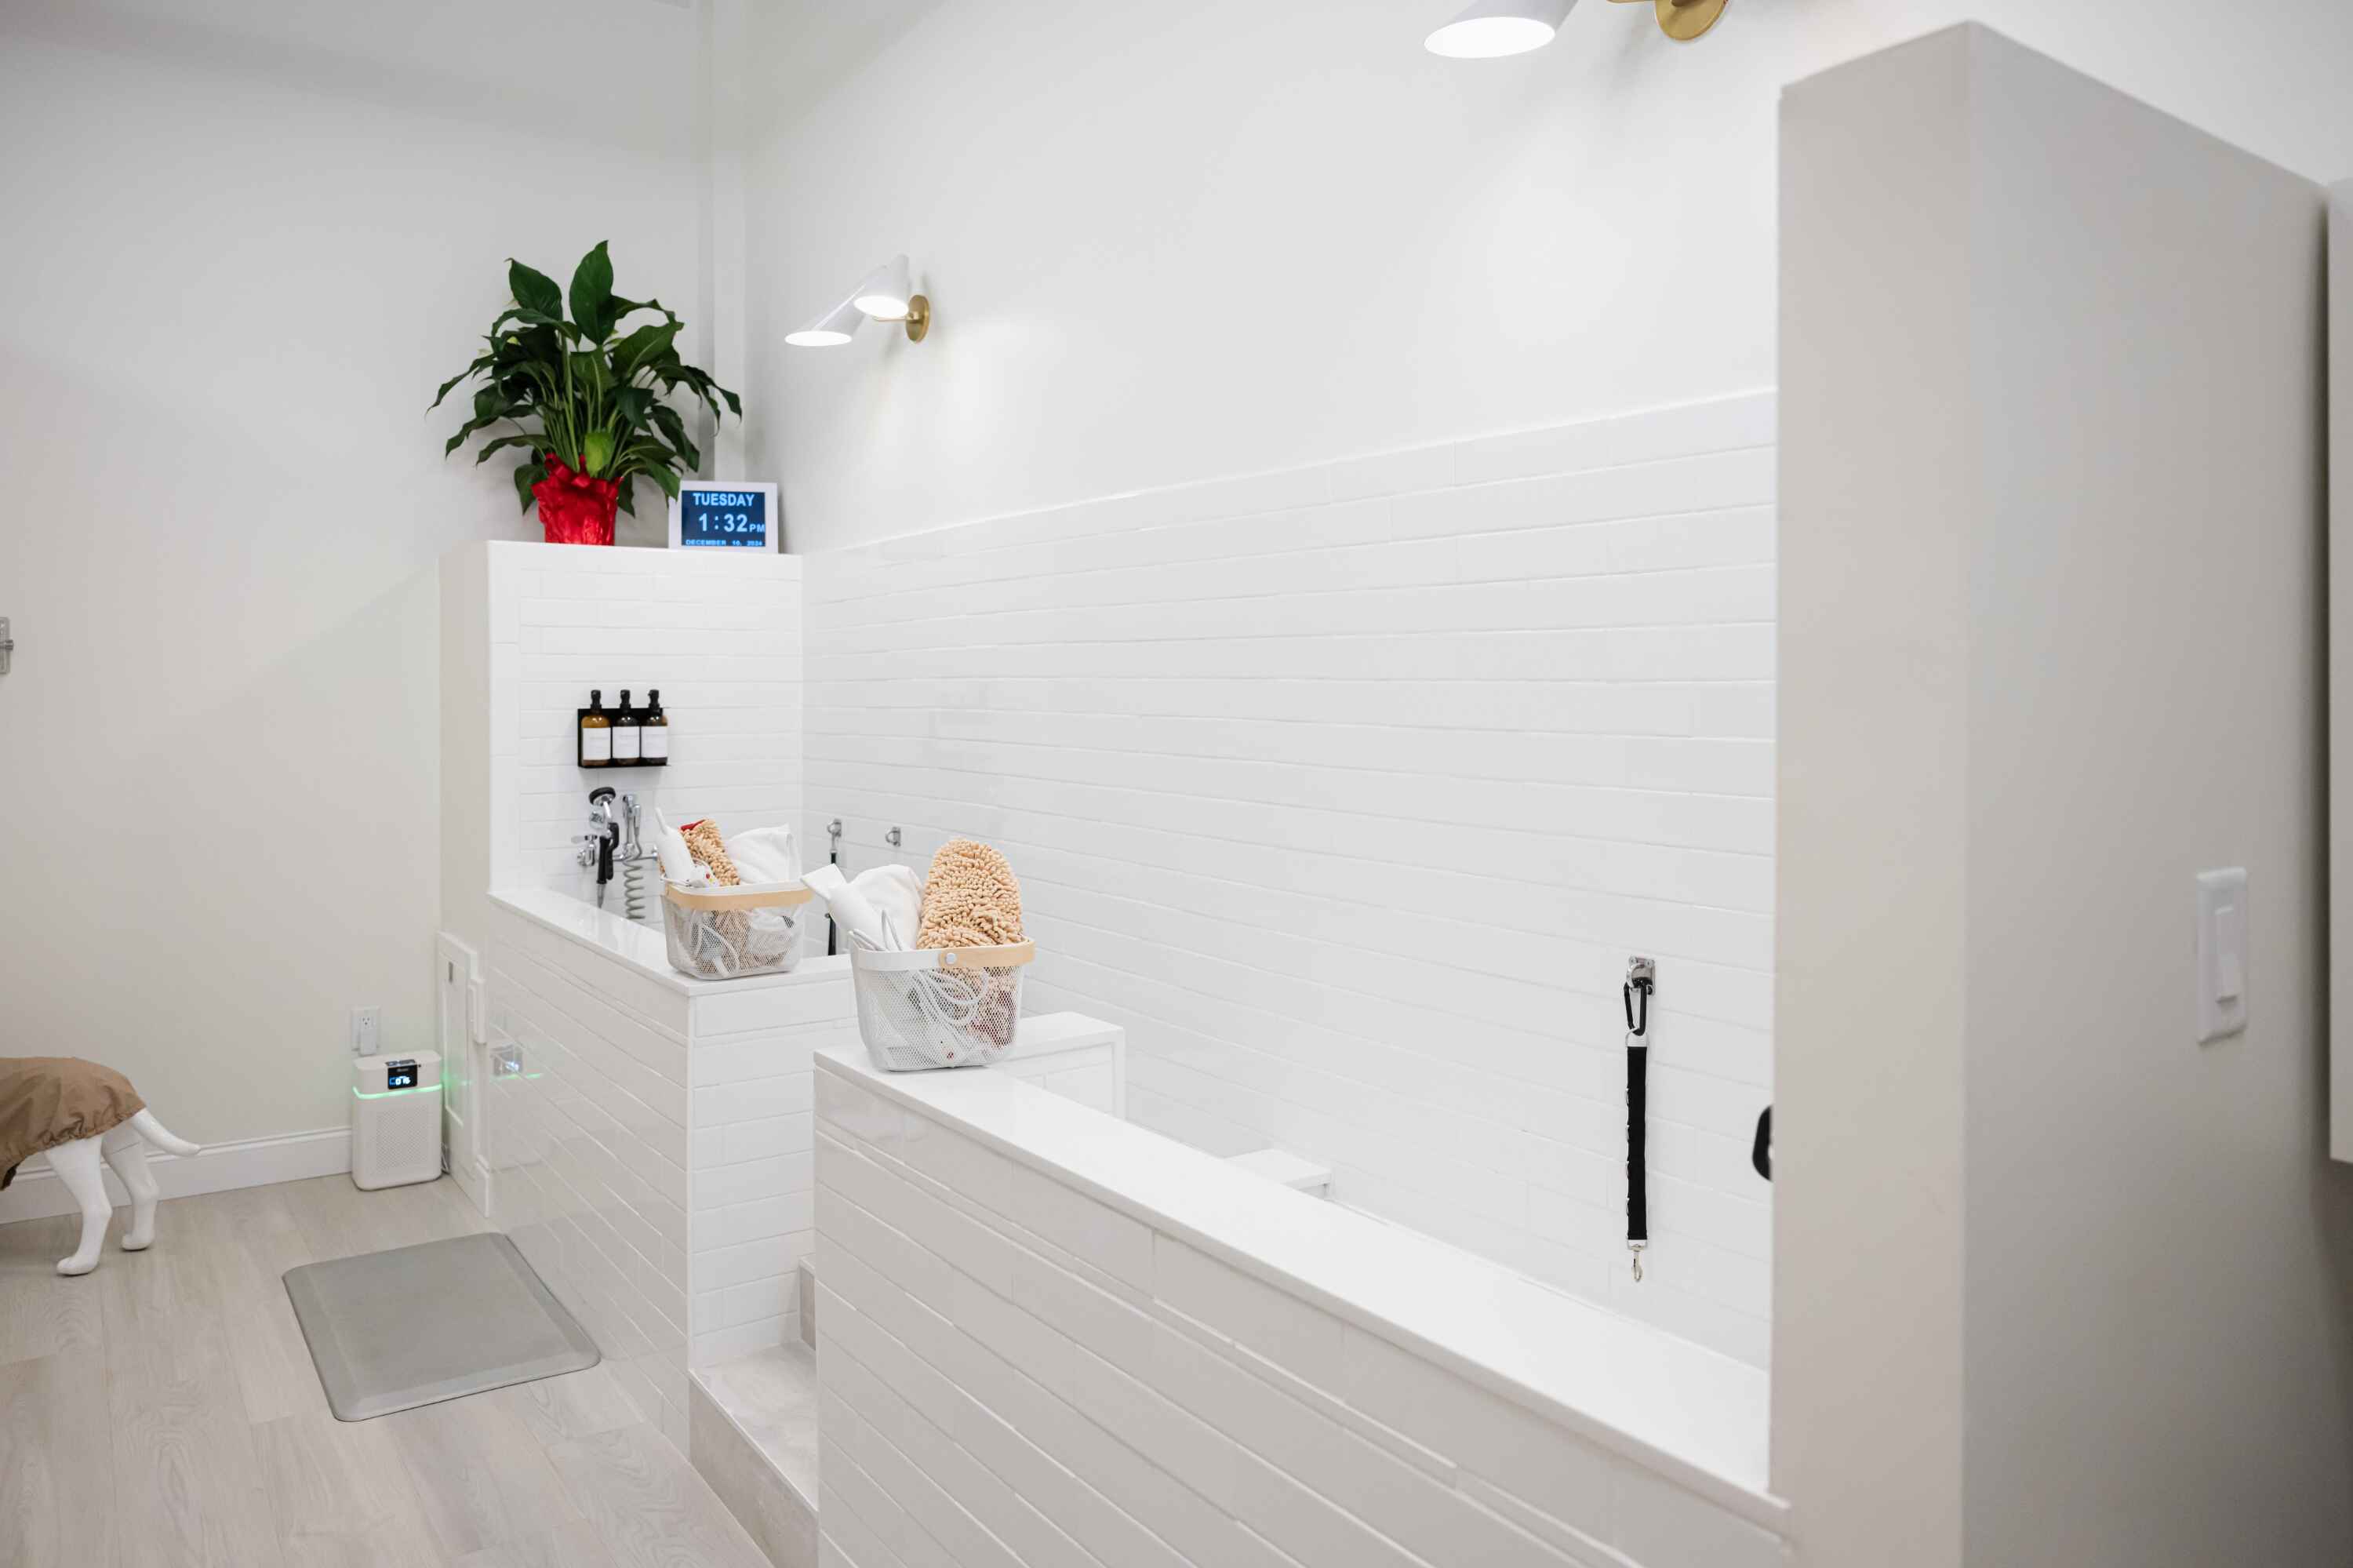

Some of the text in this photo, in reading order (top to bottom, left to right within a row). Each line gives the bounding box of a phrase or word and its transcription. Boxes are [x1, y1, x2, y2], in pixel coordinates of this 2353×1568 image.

[693, 493, 755, 507] TUESDAY
[699, 513, 766, 533] 1:32 PM
